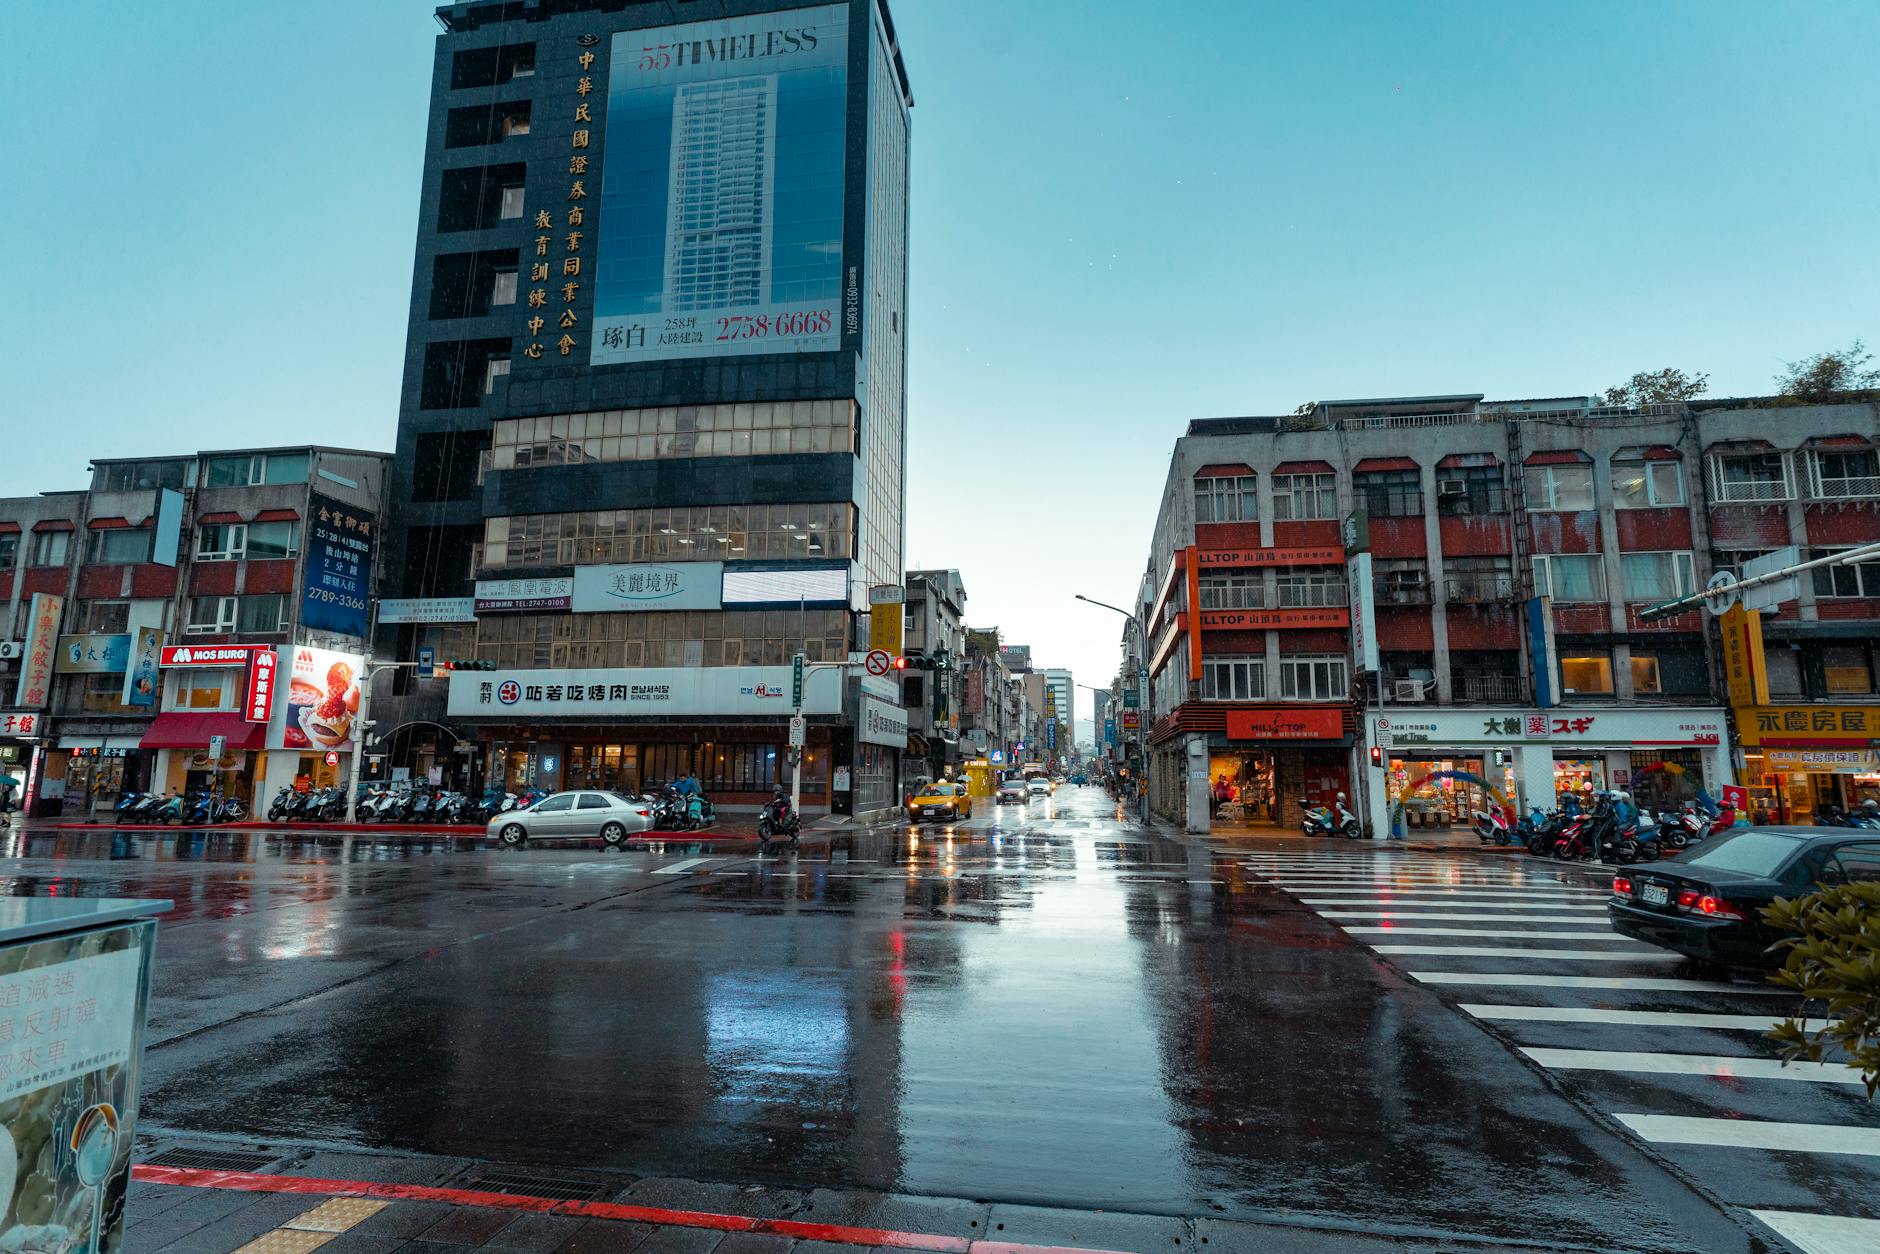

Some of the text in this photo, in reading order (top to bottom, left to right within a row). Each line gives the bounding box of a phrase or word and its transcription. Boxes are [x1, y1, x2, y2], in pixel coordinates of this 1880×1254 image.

[558, 51, 596, 357] 中華民國證券商業同業公會
[524, 209, 553, 360] 教育訓練中心
[664, 318, 697, 331] 258坪
[716, 308, 832, 342] 2758-6668
[656, 331, 703, 346] 大陸建設
[1200, 553, 1240, 563] LLTOP
[507, 580, 567, 596] 鳳凰電波
[611, 572, 679, 593] 美麗境界
[308, 586, 366, 611] 2789-3366
[1200, 615, 1245, 625] LLTOP
[193, 649, 248, 660] MOS BURG
[253, 667, 270, 720] 摩斯漢堡
[631, 684, 670, 694] 연남서식당
[0, 714, 36, 734] 子館
[1483, 717, 1522, 736] 大樹
[1552, 716, 1595, 734] スギ
[1757, 710, 1867, 732] 永慶房屋
[1694, 733, 1720, 742] SUGI
